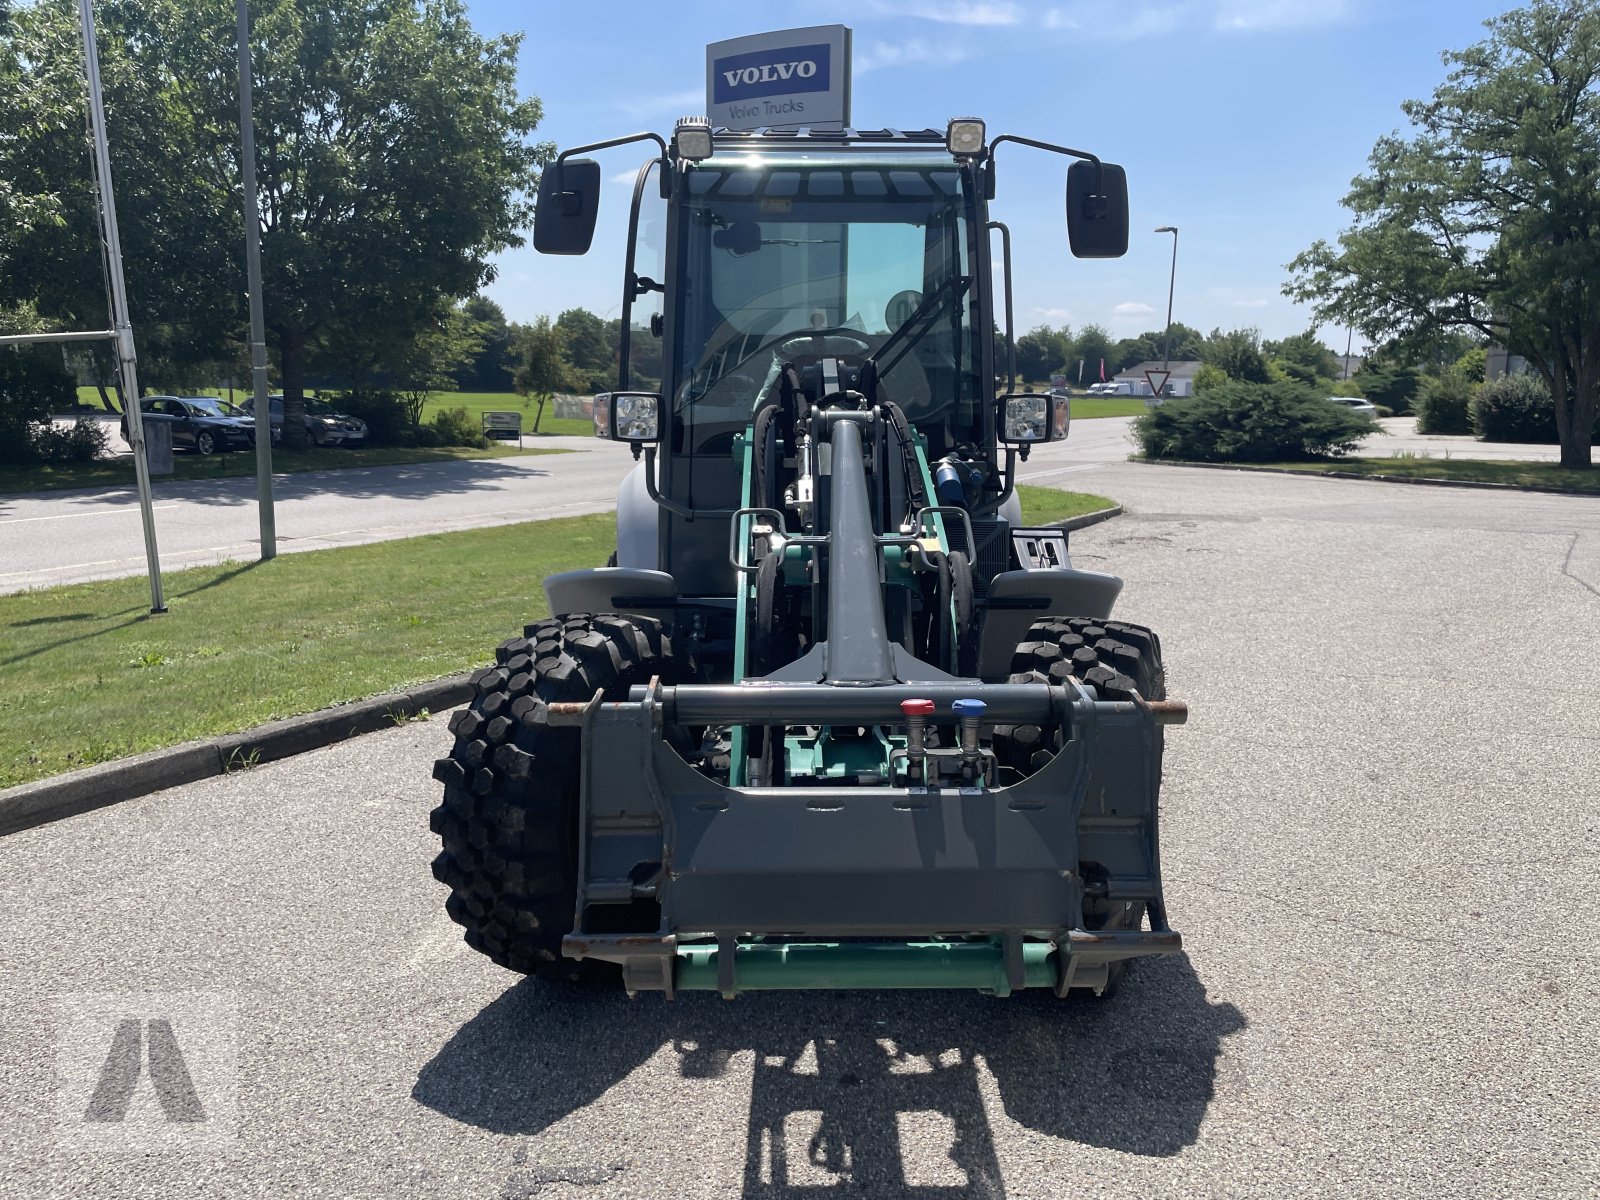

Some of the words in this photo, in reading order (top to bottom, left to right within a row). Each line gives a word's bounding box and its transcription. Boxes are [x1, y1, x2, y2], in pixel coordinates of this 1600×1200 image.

[723, 60, 817, 87] VOLVO
[729, 104, 759, 120] Volvo
[763, 99, 804, 116] Trucks
